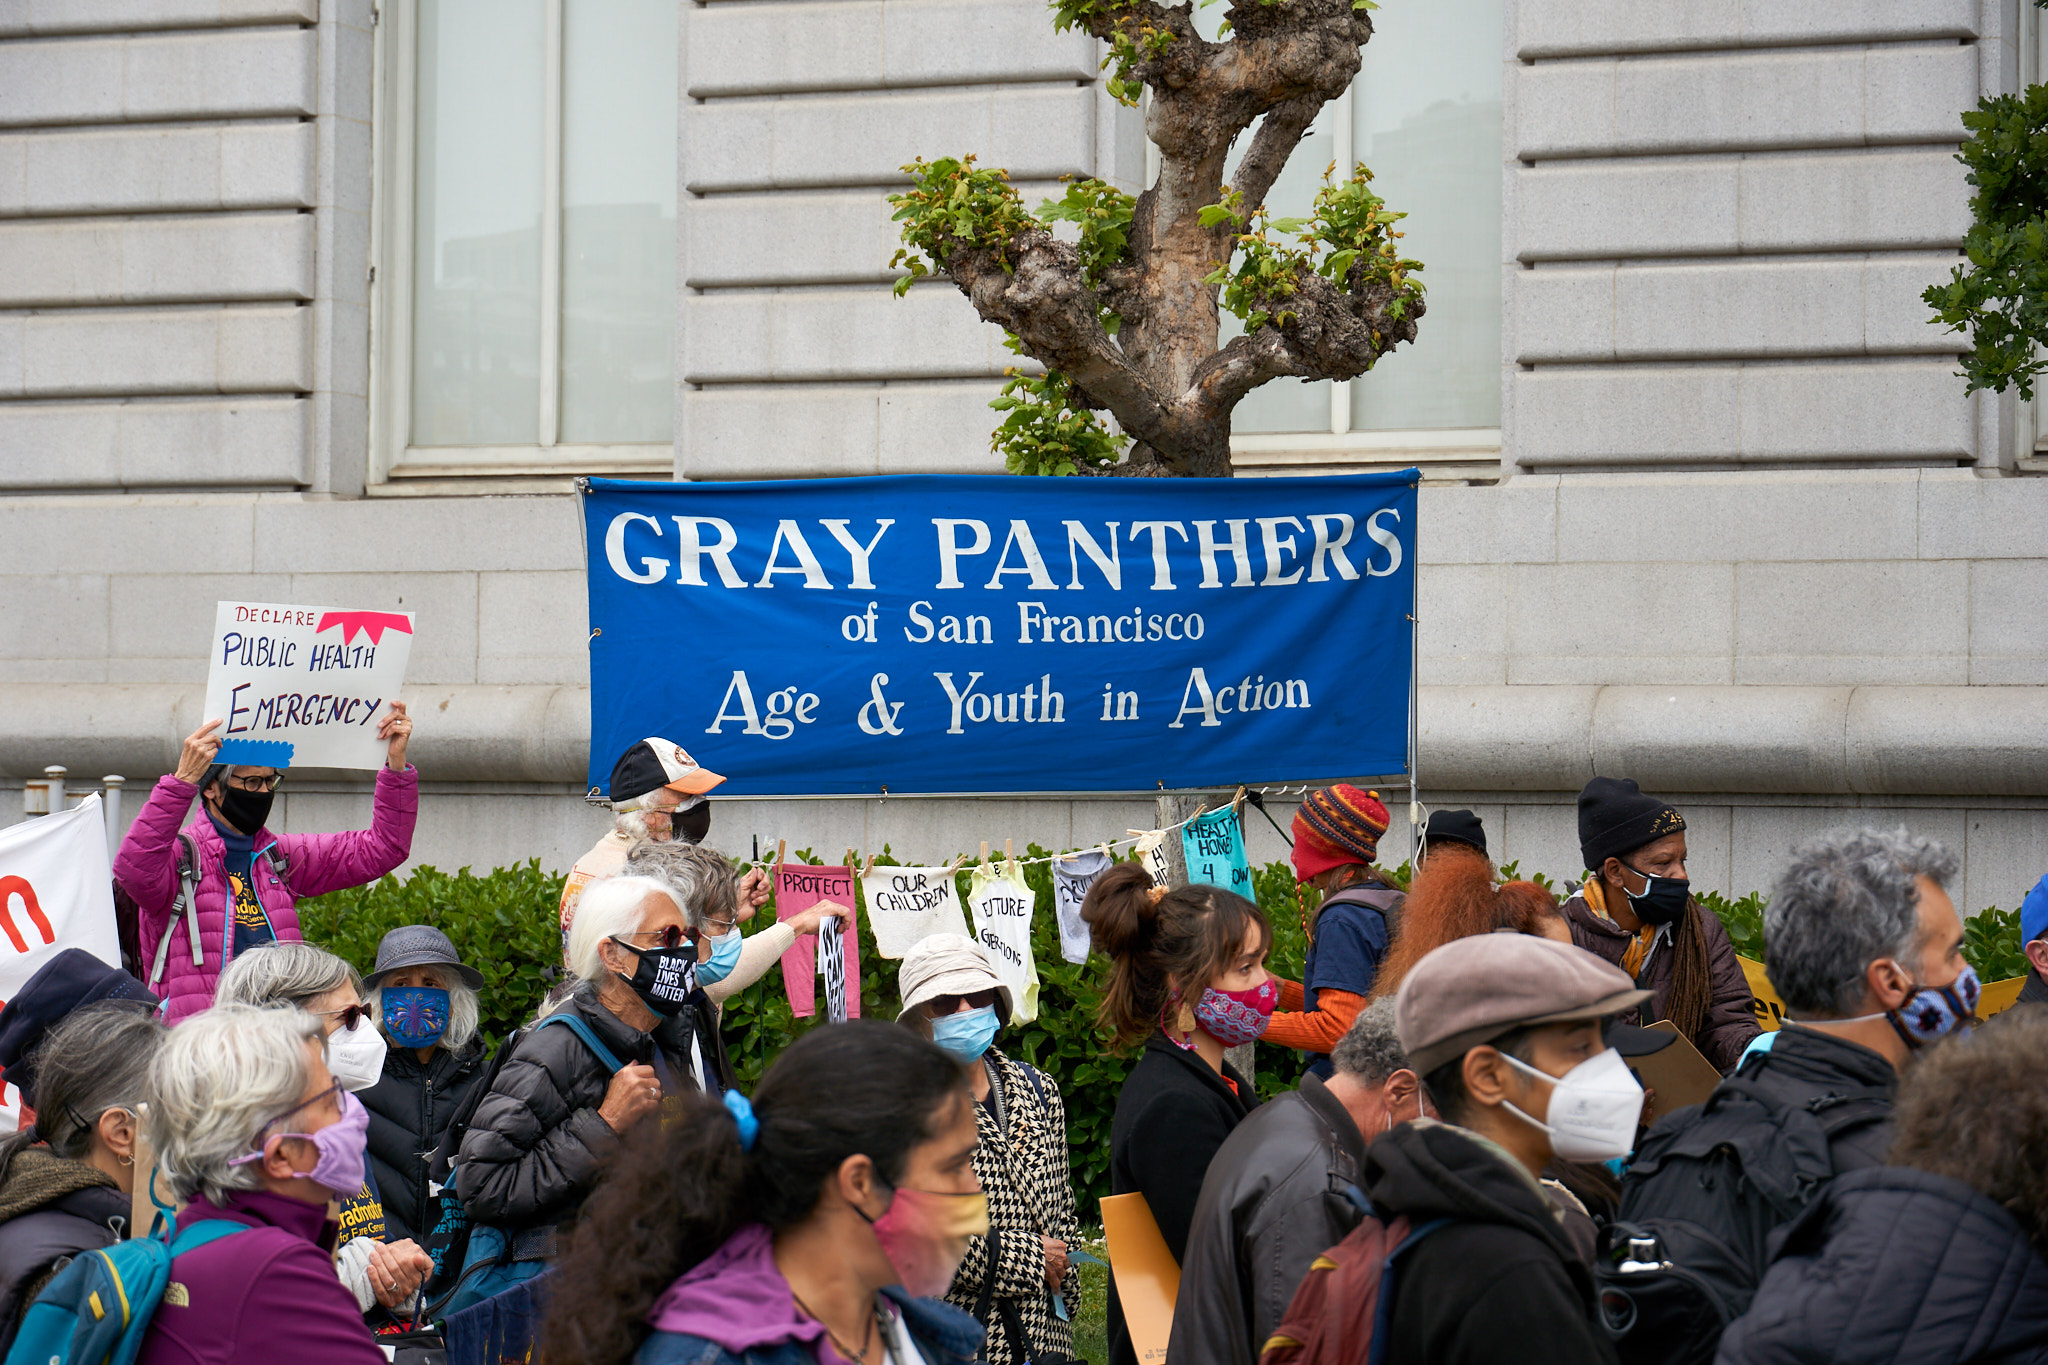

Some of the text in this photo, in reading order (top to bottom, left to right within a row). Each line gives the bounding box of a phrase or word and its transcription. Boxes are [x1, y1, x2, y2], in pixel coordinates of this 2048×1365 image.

[604, 508, 1403, 591] GRAY PANTHERS
[235, 606, 315, 626] DECLARE
[841, 600, 1205, 645] of San Francisco
[309, 643, 376, 672] HEALTH
[226, 682, 382, 734] EMERGENCY
[704, 667, 1312, 740] Age & Youth in Action
[783, 873, 851, 896] PROTECT
[892, 873, 927, 893] OUR
[1202, 863, 1214, 884] 4
[876, 879, 949, 912] CHILDREN
[659, 955, 688, 973] BLACK
[655, 969, 680, 987] LIVES
[650, 982, 685, 1003] MATTER
